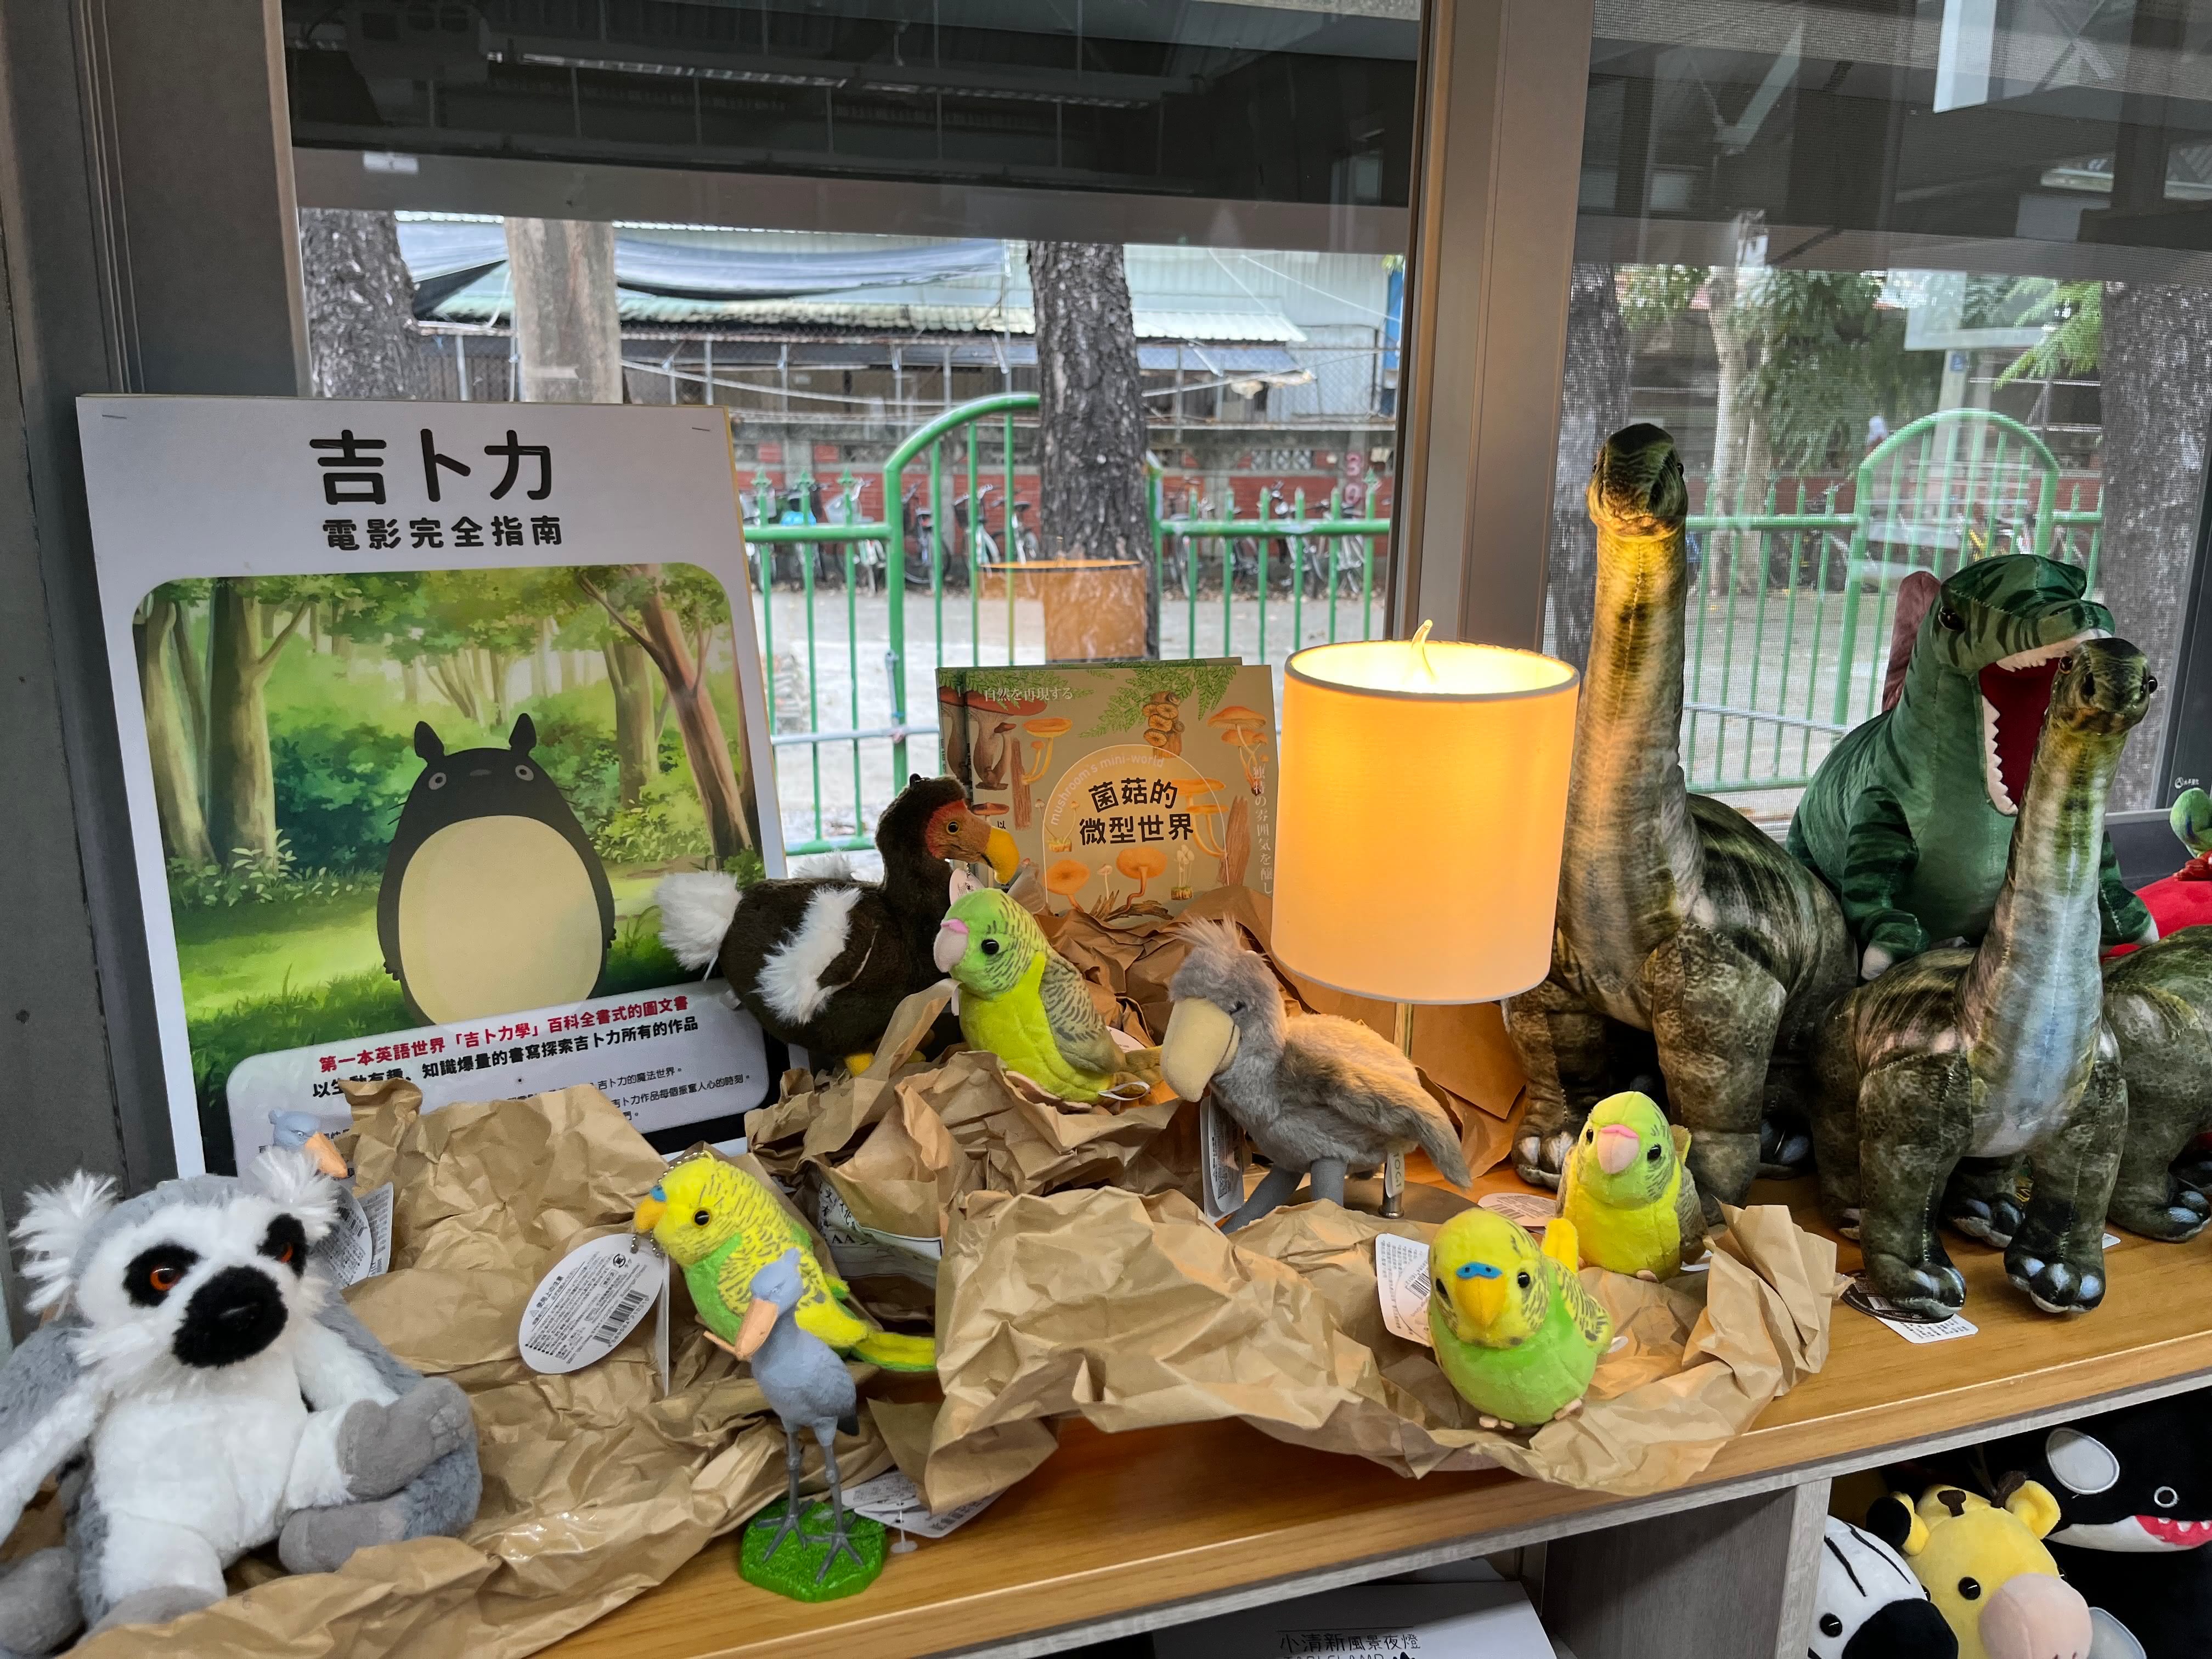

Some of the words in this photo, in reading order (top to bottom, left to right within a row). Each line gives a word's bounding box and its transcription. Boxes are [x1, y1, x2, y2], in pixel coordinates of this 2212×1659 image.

[309, 428, 552, 505] 吉卜力
[323, 515, 562, 550] 電影完全指南
[985, 687, 1073, 702] 自然を再現する
[1101, 754, 1165, 769] mini-world
[1088, 777, 1178, 813] 菌菇的
[1079, 813, 1194, 846] 微型世界
[319, 995, 689, 1073] 第一本英語世界「吉卜力學」百科全書式的圖文書
[1279, 1633, 1420, 1653] 小清新風景夜燈
